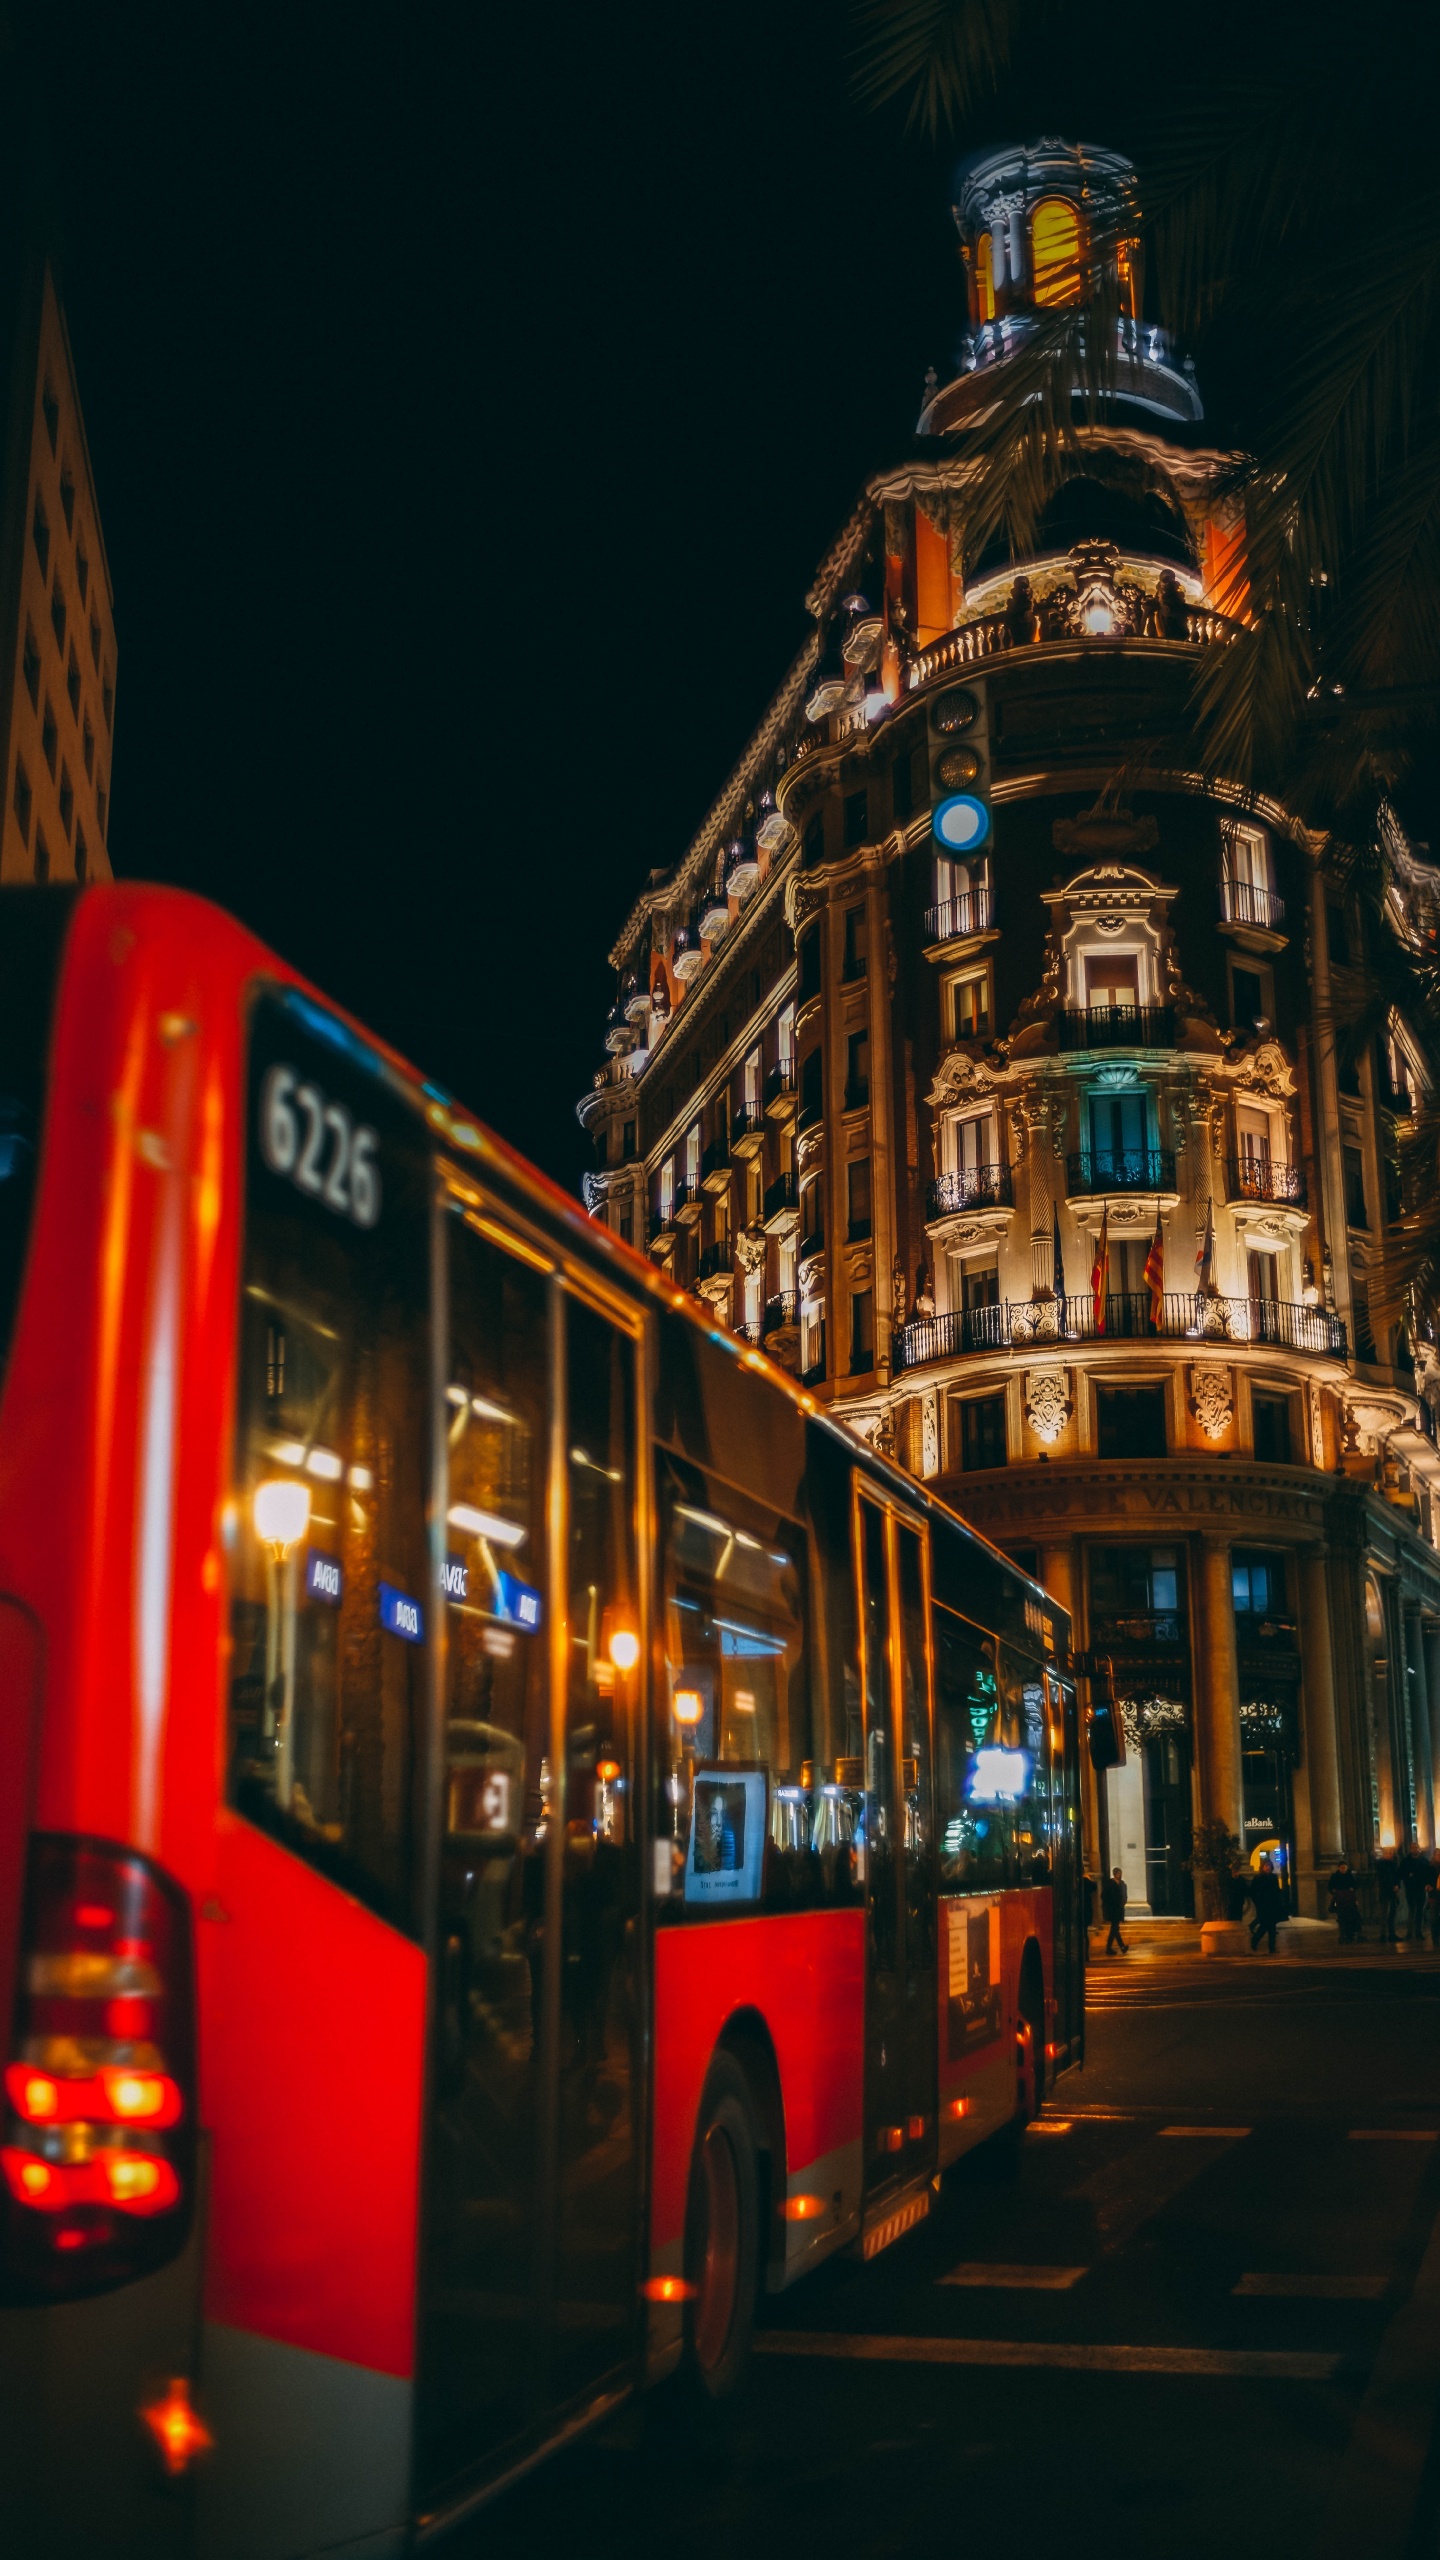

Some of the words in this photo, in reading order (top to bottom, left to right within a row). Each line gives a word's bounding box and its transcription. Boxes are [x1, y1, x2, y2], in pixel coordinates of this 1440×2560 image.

[261, 1064, 381, 1228] 6226
[1084, 1486, 1125, 1514] DE
[1143, 1487, 1290, 1517] VALENCIA
